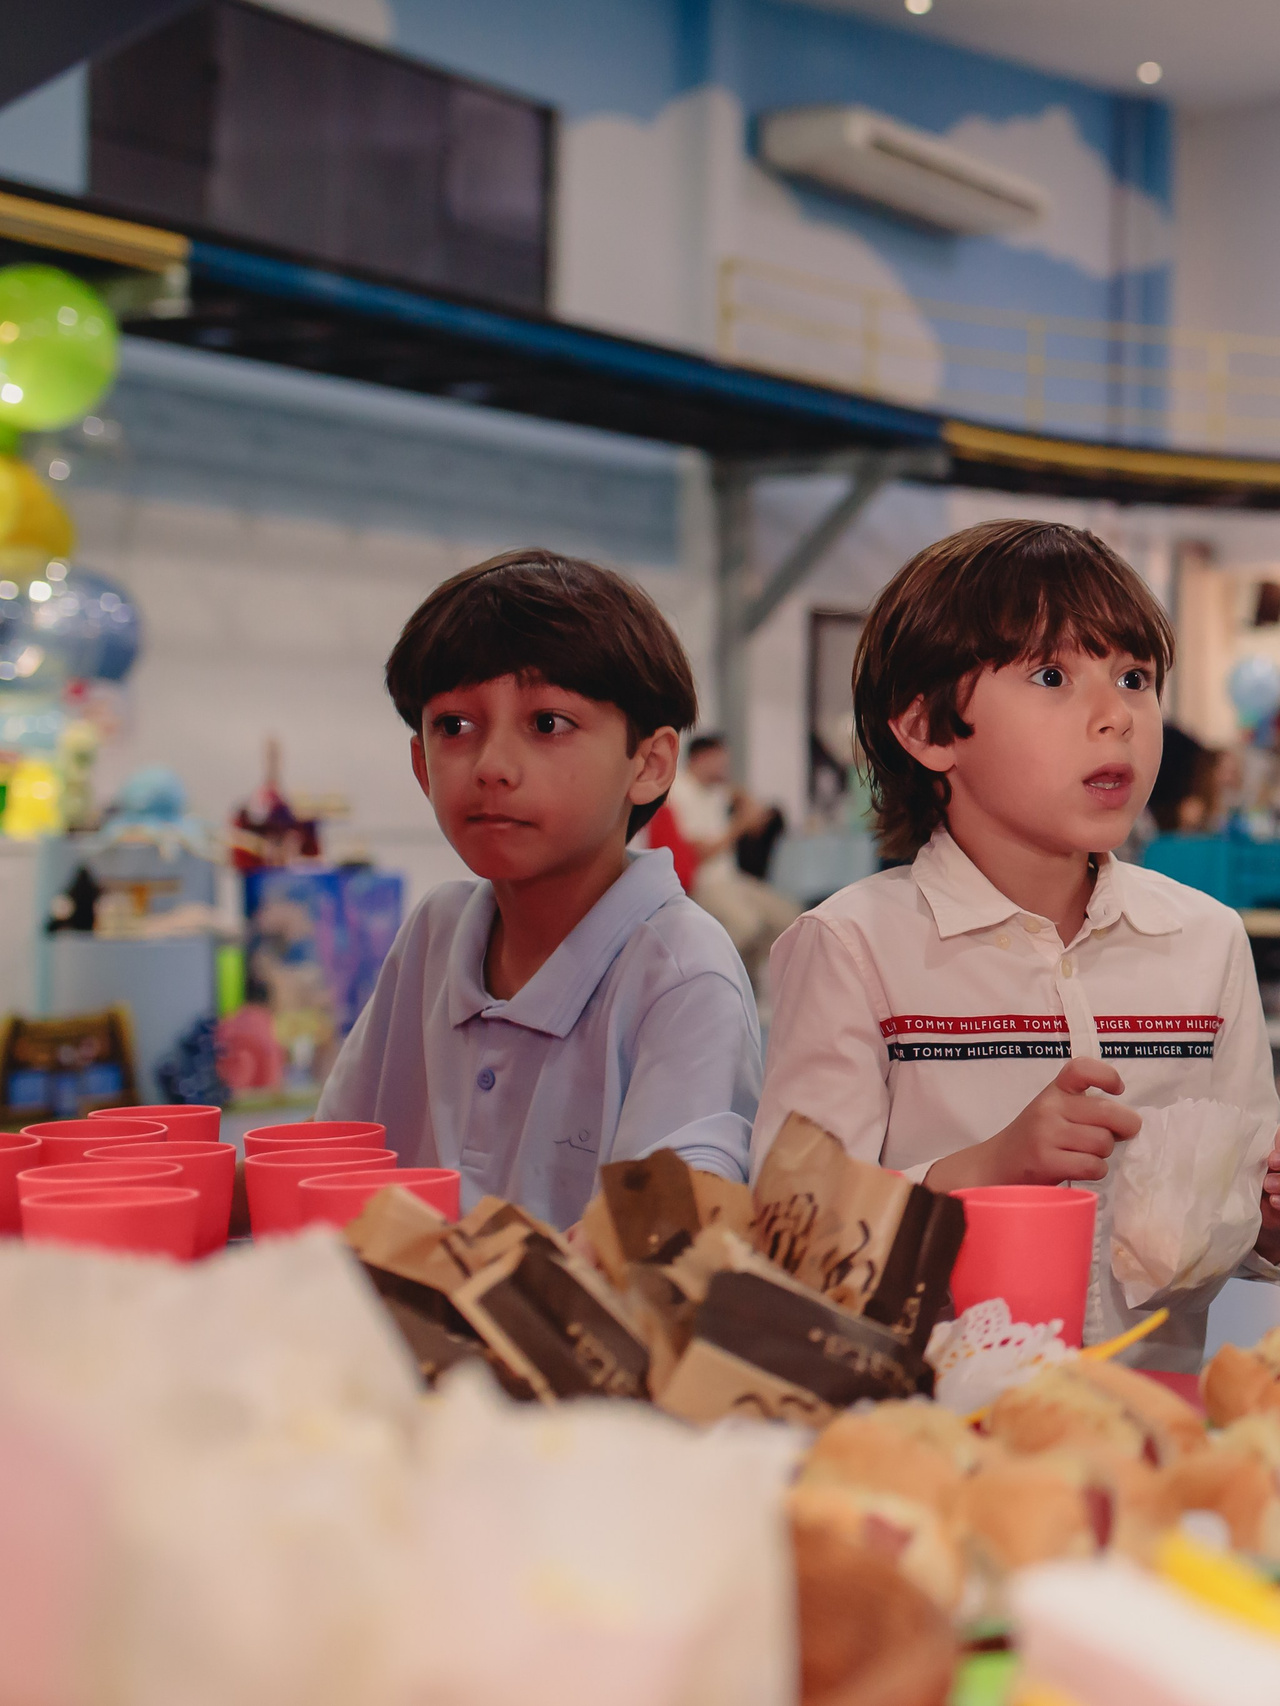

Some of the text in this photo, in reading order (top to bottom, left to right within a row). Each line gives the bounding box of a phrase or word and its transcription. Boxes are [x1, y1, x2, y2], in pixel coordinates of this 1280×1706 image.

[904, 1019, 954, 1030] TOMMY
[960, 1019, 1016, 1030] HILFIGER
[1023, 1020, 1068, 1029] TOMM
[1094, 1020, 1131, 1029] LFIGER
[1136, 1020, 1181, 1029] TOMMY
[912, 1047, 962, 1057] TOMMY
[967, 1045, 1022, 1056] HILFIGER
[1134, 1045, 1182, 1055] HILFIGER
